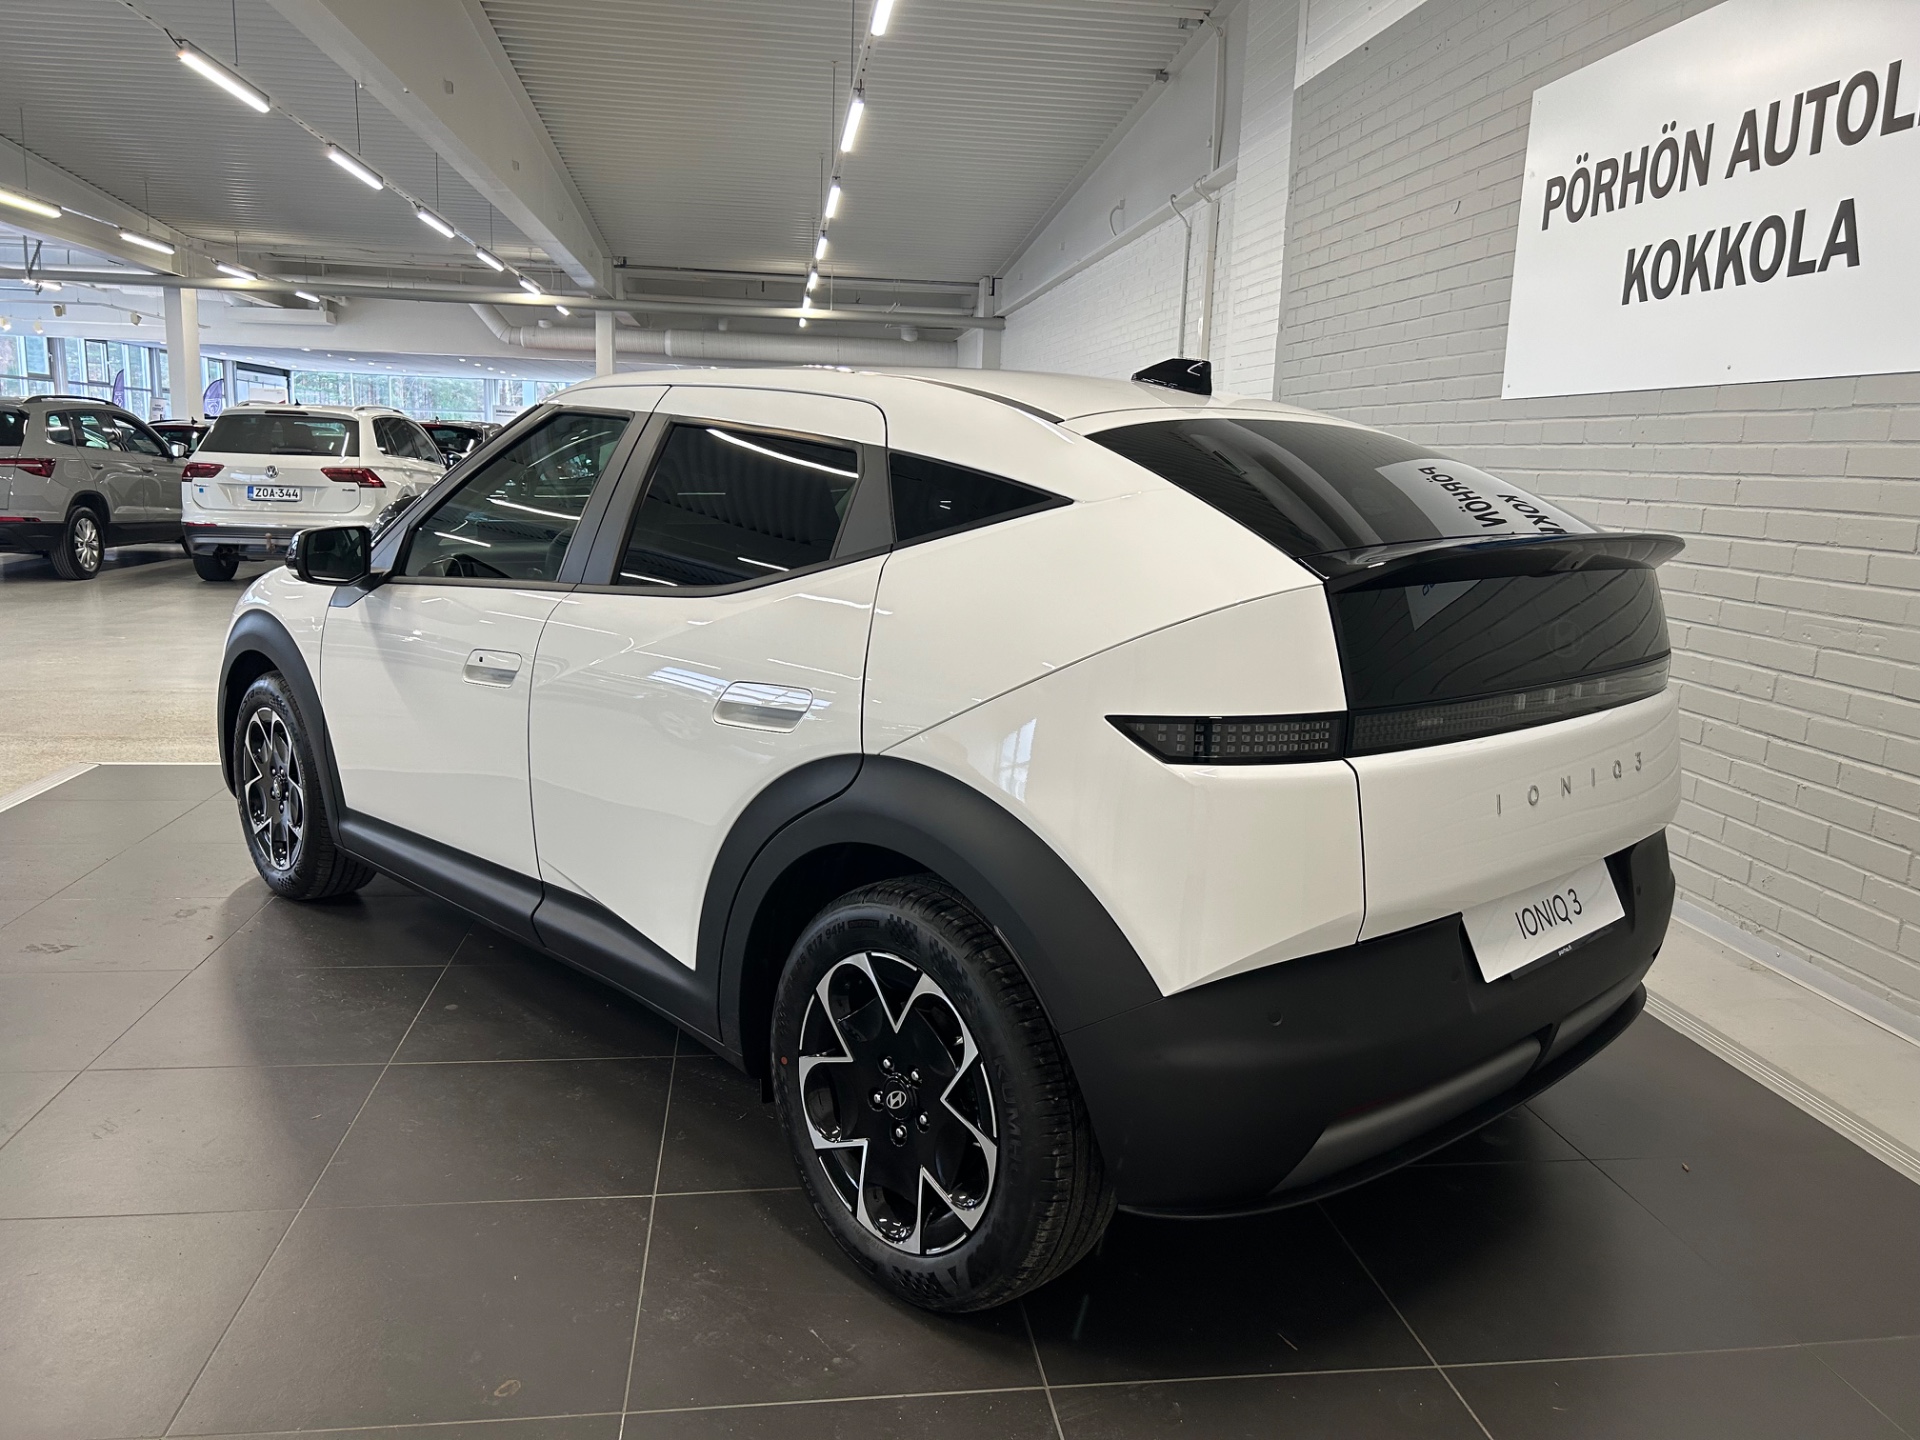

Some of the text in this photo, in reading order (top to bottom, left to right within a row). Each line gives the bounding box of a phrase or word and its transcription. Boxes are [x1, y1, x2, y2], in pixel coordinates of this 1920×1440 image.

[1541, 59, 1920, 231] PÖRHÖN AUTOL
[1621, 198, 1860, 305] KOKKOLA
[255, 488, 299, 499] ZOA-344
[1514, 888, 1583, 940] IONIQ 3
